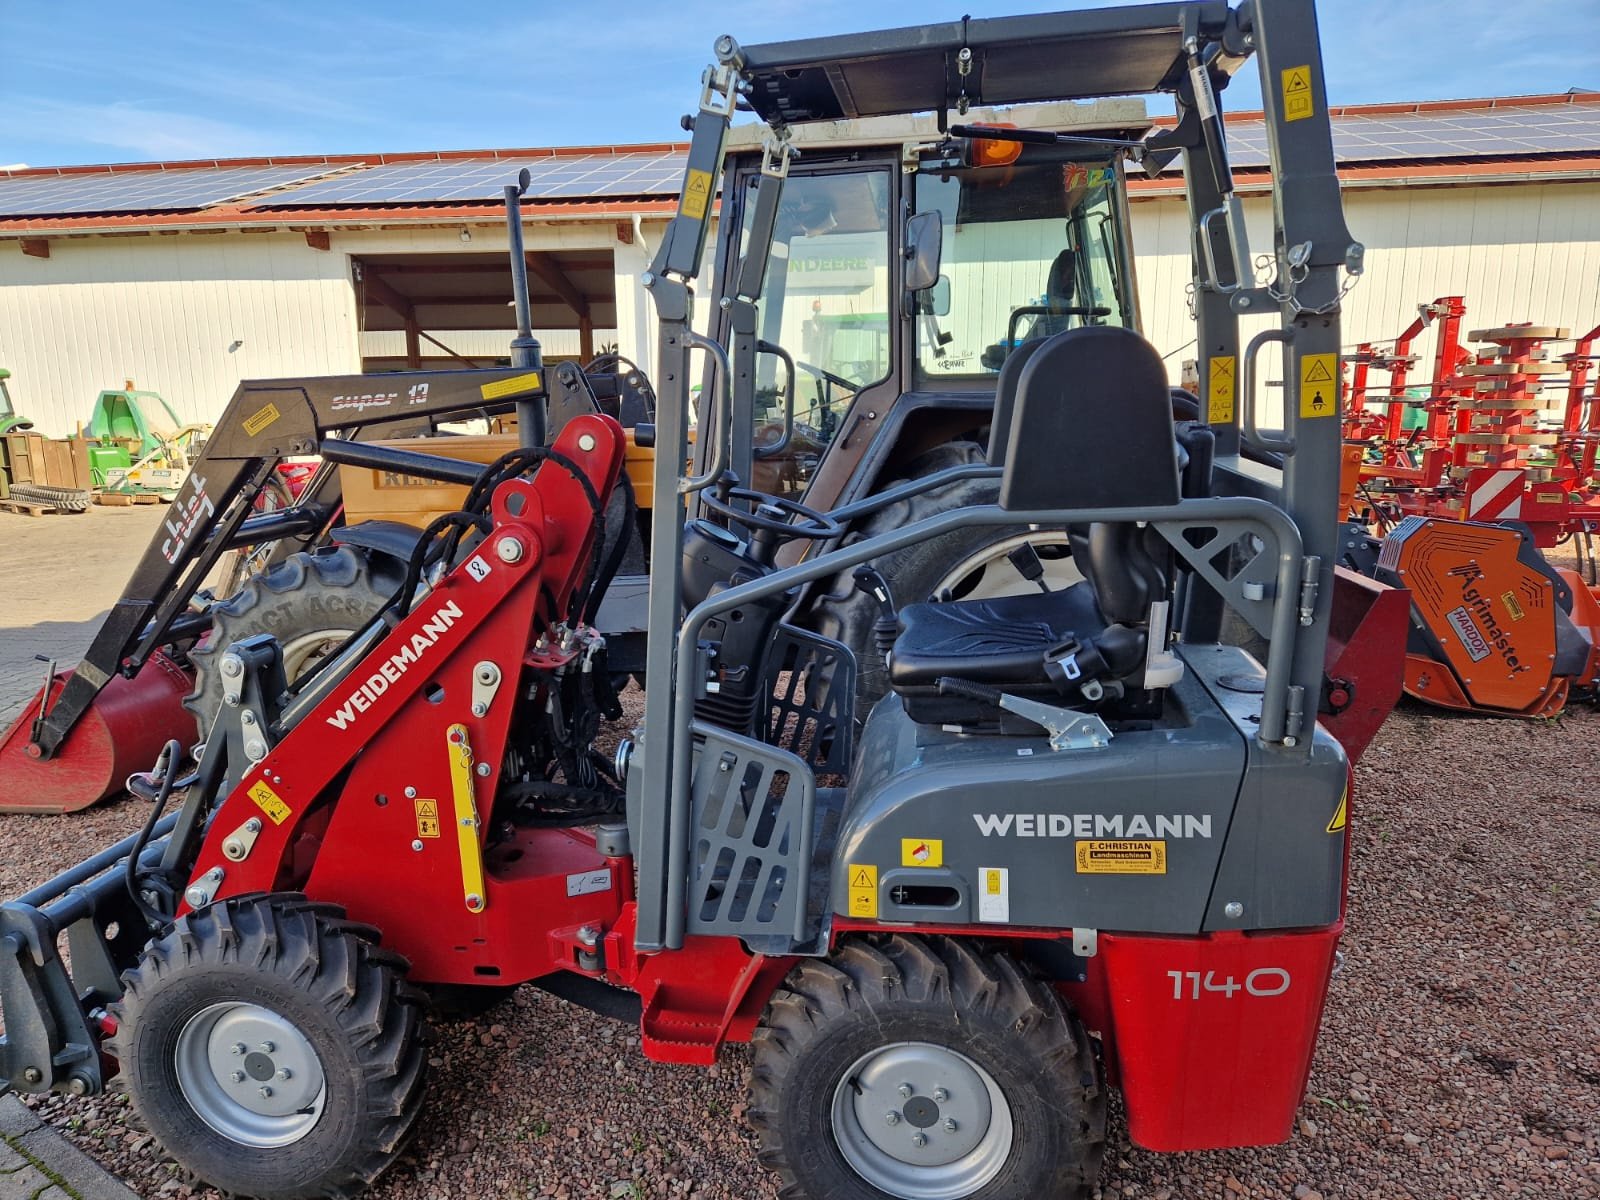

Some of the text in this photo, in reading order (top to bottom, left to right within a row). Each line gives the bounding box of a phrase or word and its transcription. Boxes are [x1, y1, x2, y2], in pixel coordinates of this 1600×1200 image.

[331, 383, 429, 412] super 13
[1450, 563, 1525, 673] Agrimaster
[1454, 609, 1488, 655] HARDOX
[326, 600, 464, 731] WEIDEMANN
[973, 813, 1212, 838] WEIDEMANN
[1091, 851, 1150, 859] Landmaschinen
[1167, 967, 1291, 1000] 1140
